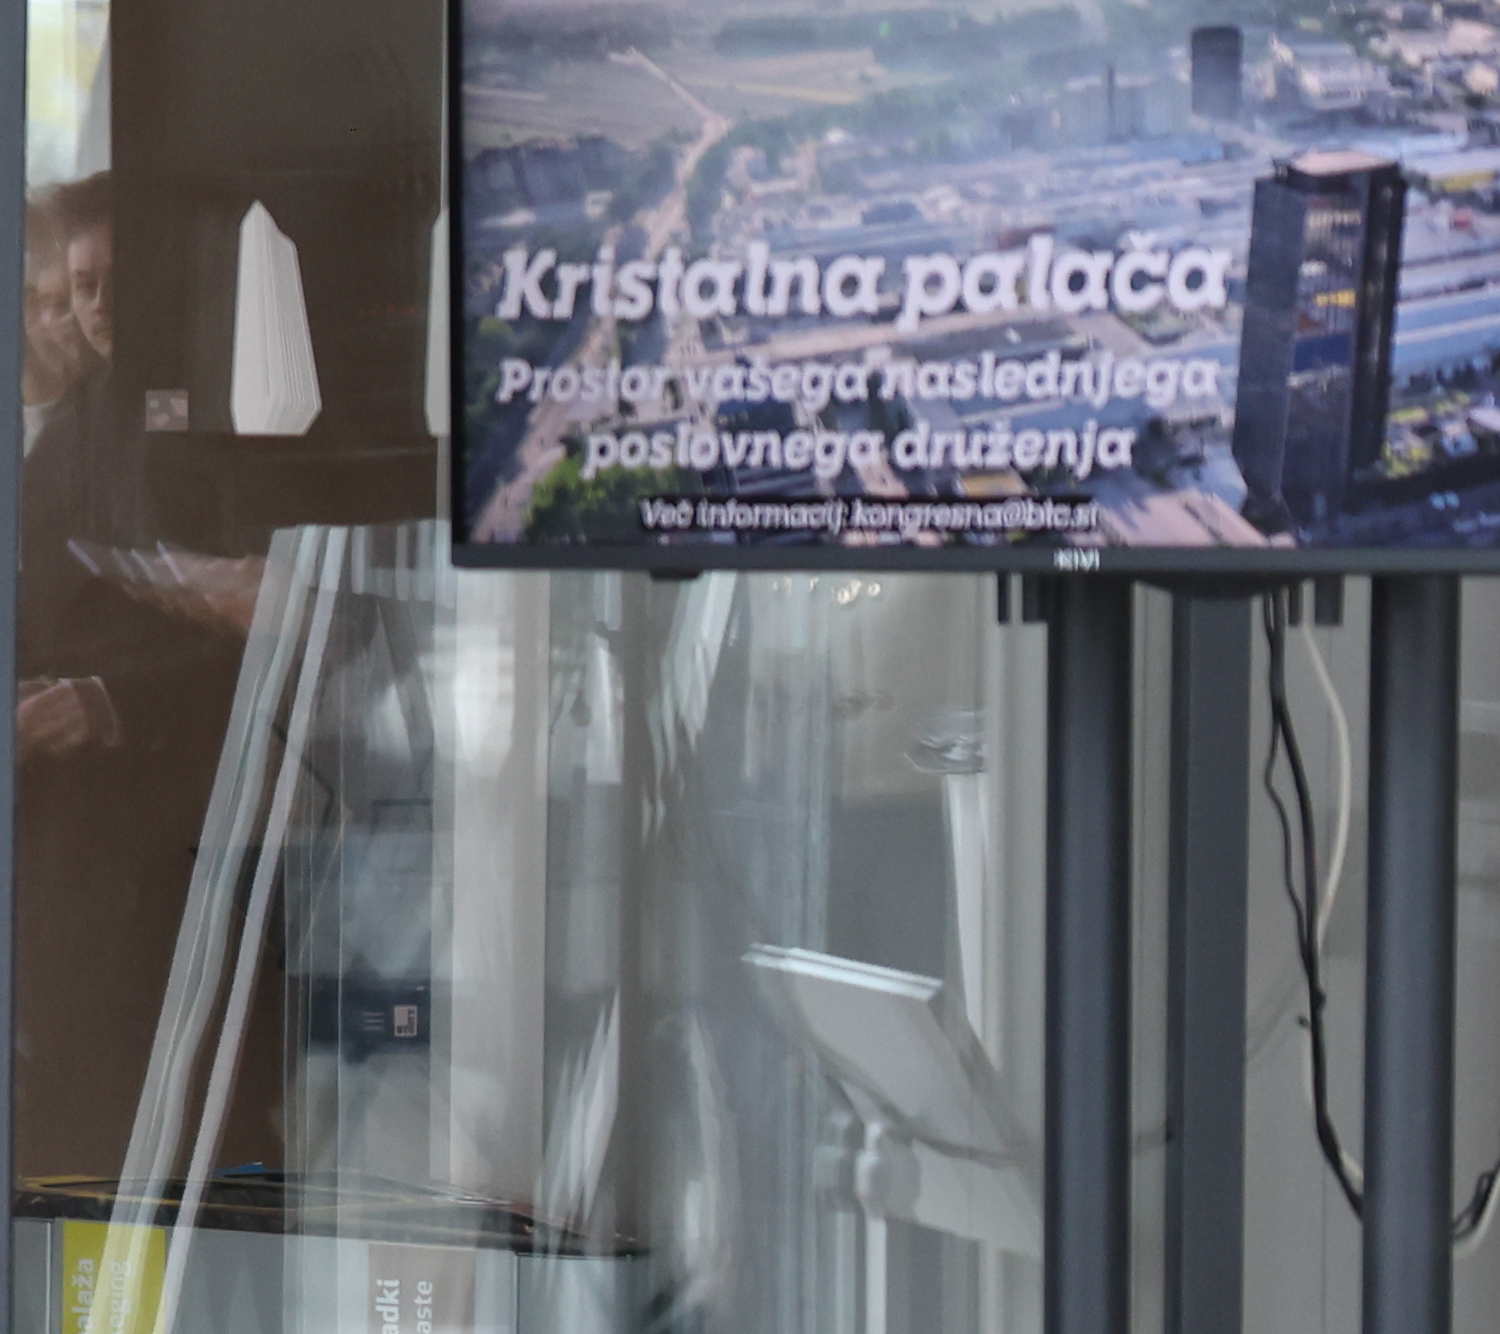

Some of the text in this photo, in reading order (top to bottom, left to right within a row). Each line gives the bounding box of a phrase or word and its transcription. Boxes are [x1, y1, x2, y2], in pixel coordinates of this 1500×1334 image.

[496, 229, 1232, 333] Kristalna palača
[496, 349, 1220, 413] Prostor vašega naslednjega
[580, 418, 1136, 481] poslovnega druženja
[639, 497, 695, 530] Več
